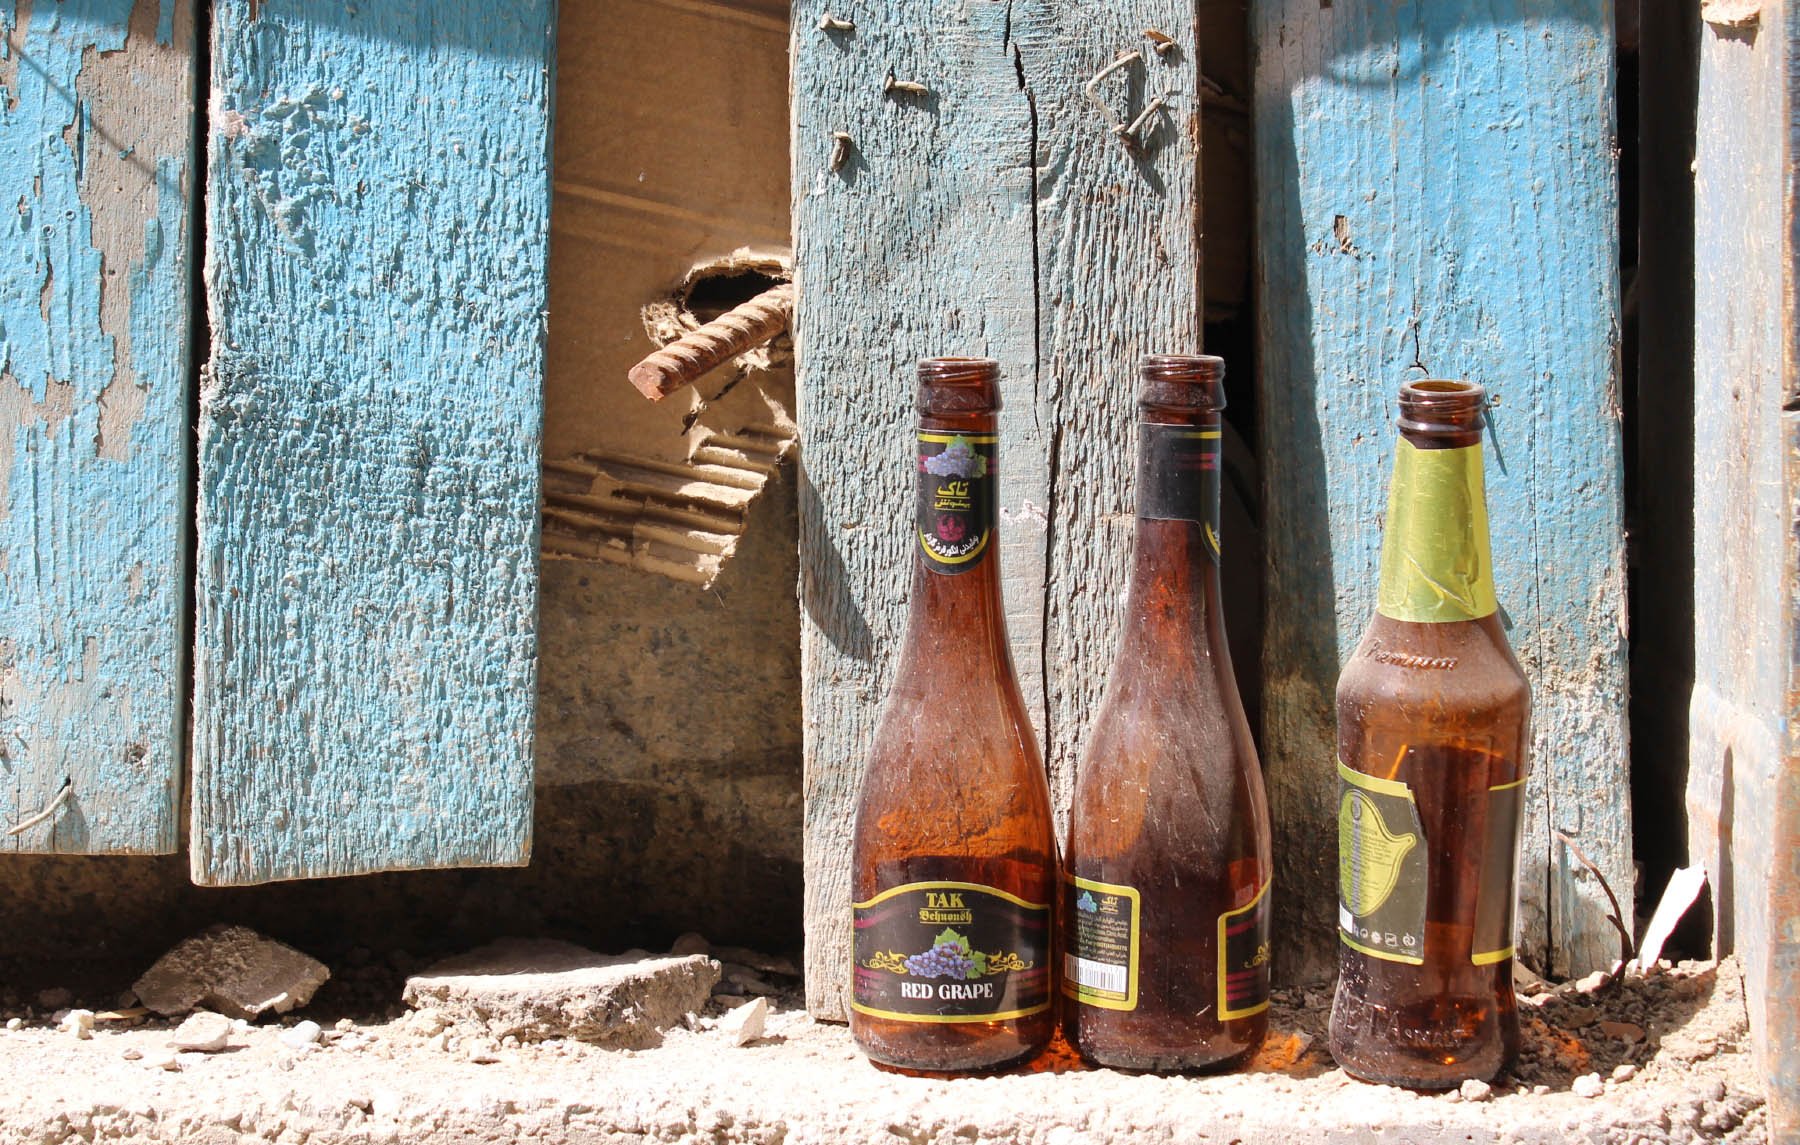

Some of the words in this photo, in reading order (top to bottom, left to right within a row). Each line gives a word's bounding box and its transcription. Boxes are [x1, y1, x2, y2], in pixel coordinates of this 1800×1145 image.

[937, 481, 969, 496] تاک
[926, 892, 965, 908] TAK
[901, 982, 933, 999] RED
[938, 982, 993, 1000] GRAPE
